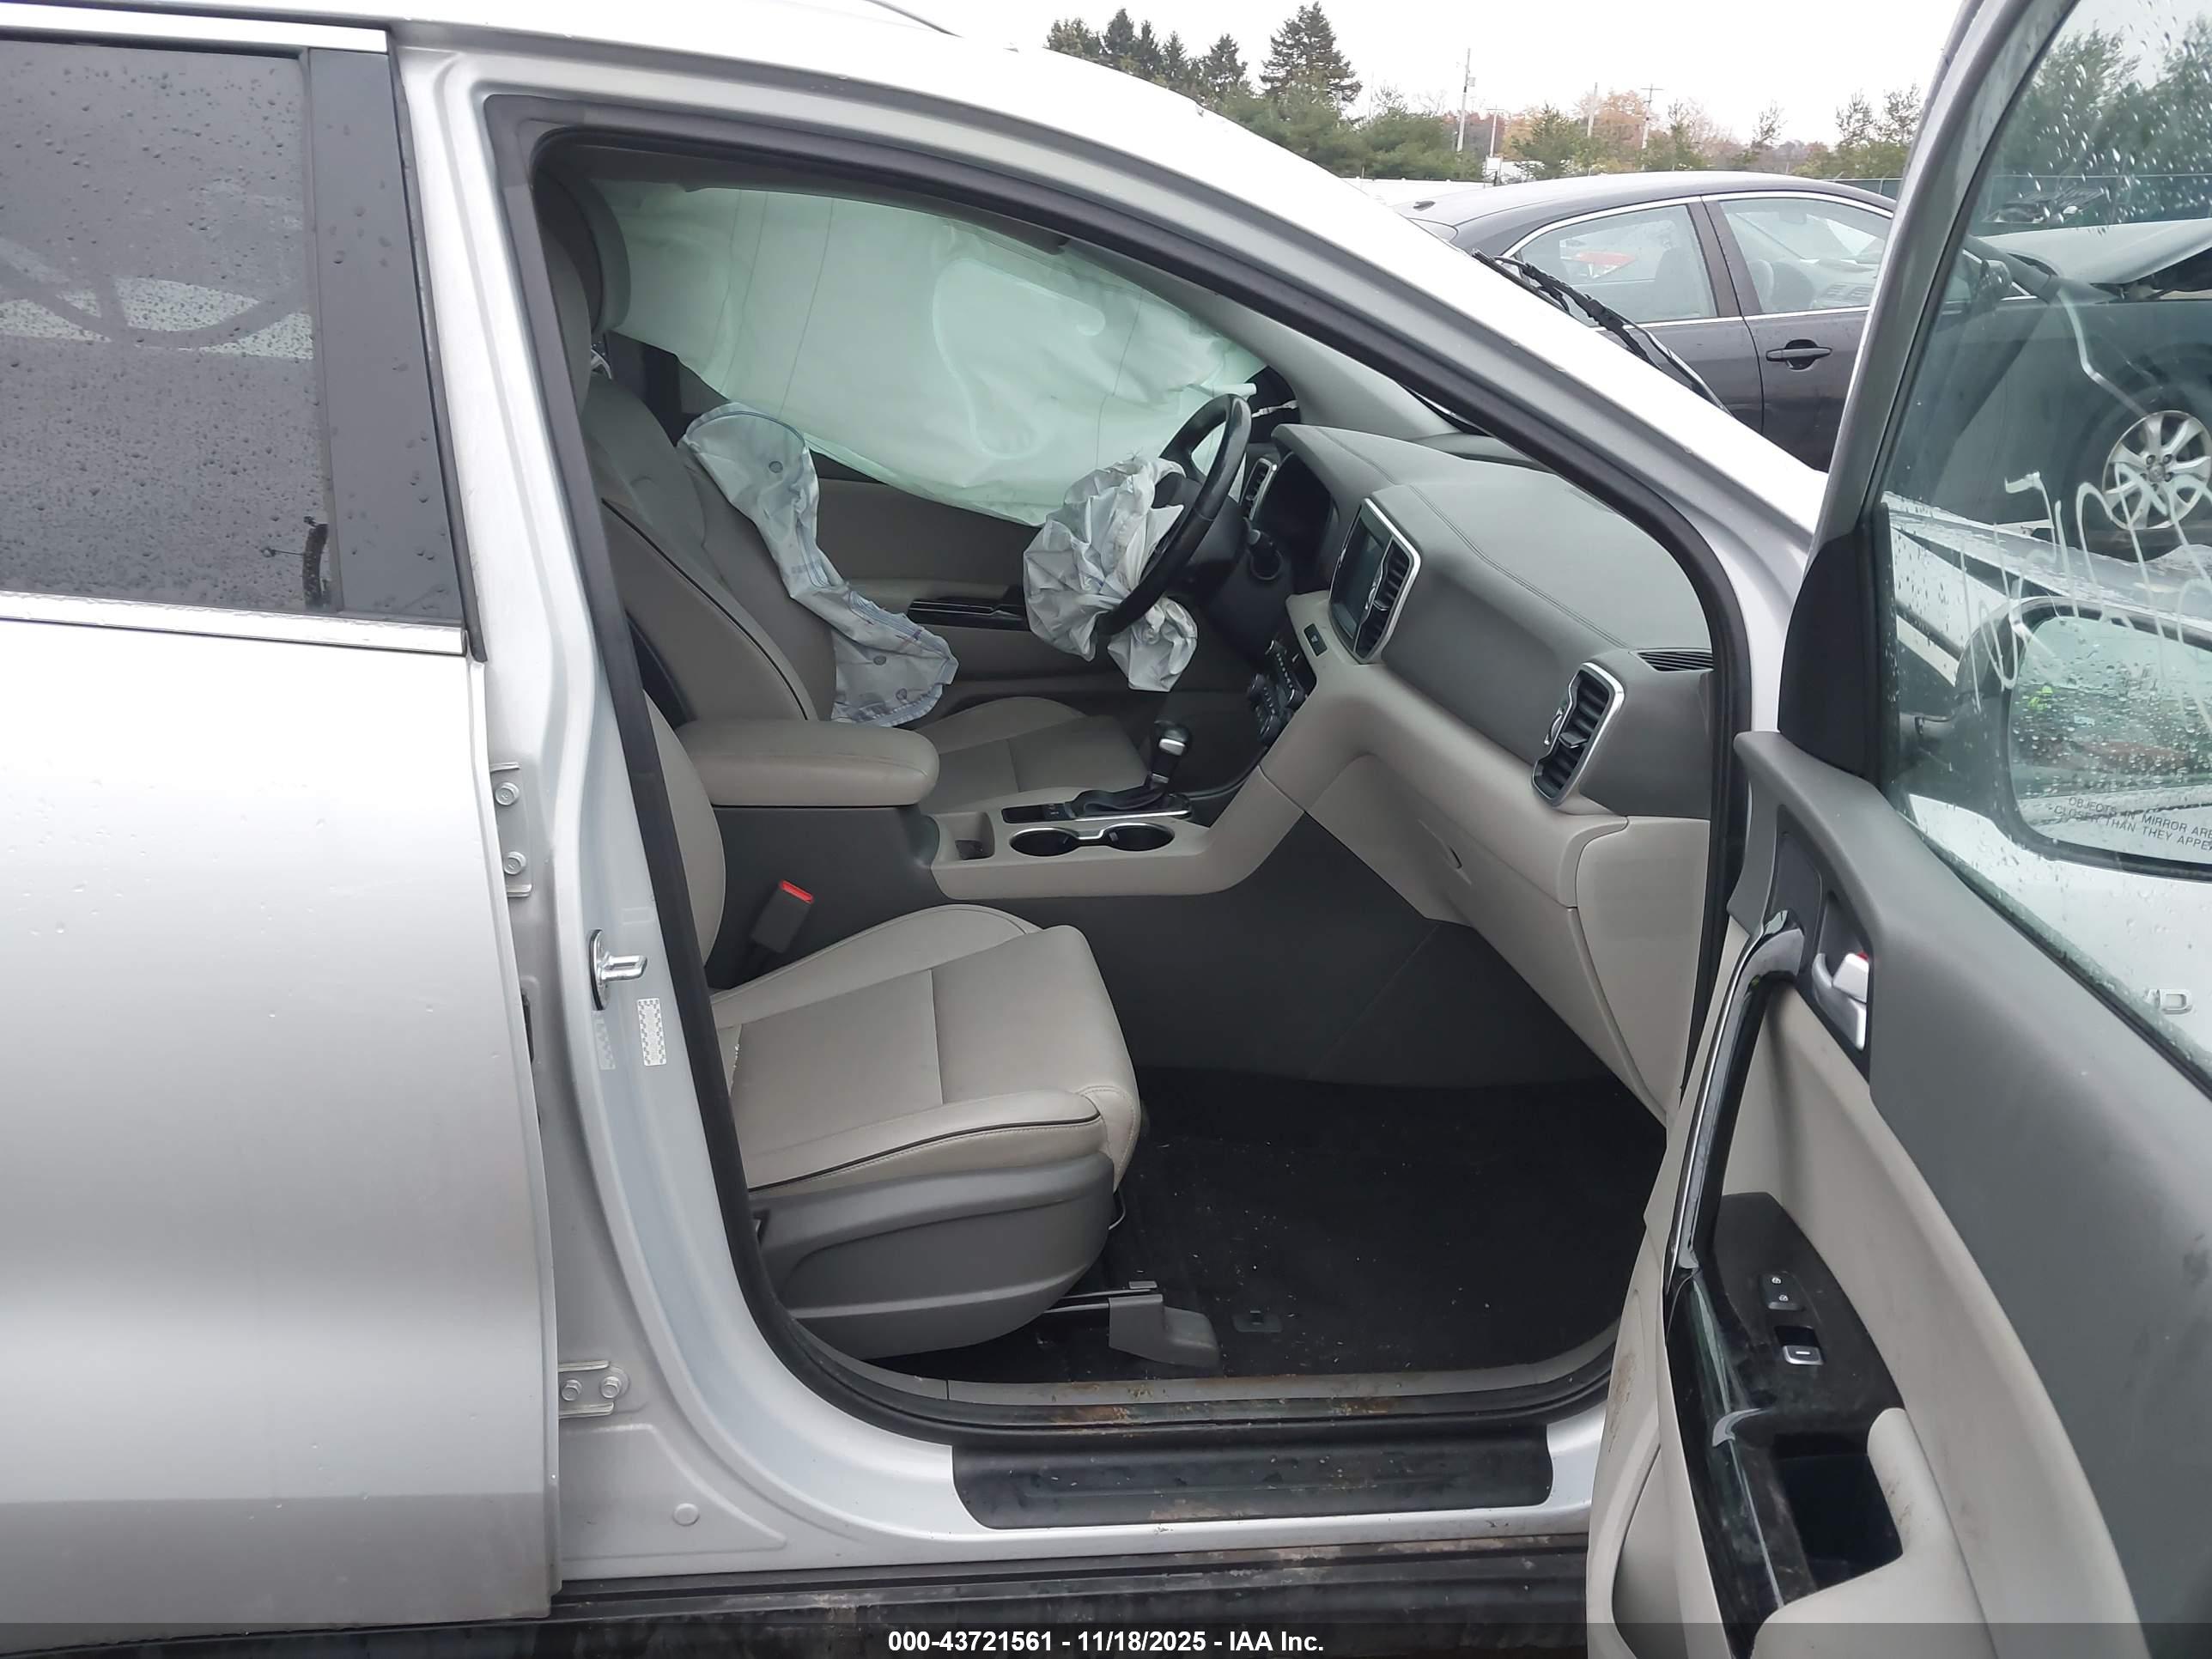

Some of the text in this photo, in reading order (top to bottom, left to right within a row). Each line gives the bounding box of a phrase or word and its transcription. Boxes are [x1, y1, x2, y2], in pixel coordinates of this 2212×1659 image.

[2068, 796, 2117, 816] OBJECTS
[2142, 814, 2188, 832] MIRROR
[2191, 827, 2212, 840] ARE
[2105, 817, 2136, 832] THAN
[2142, 825, 2172, 841] THEY
